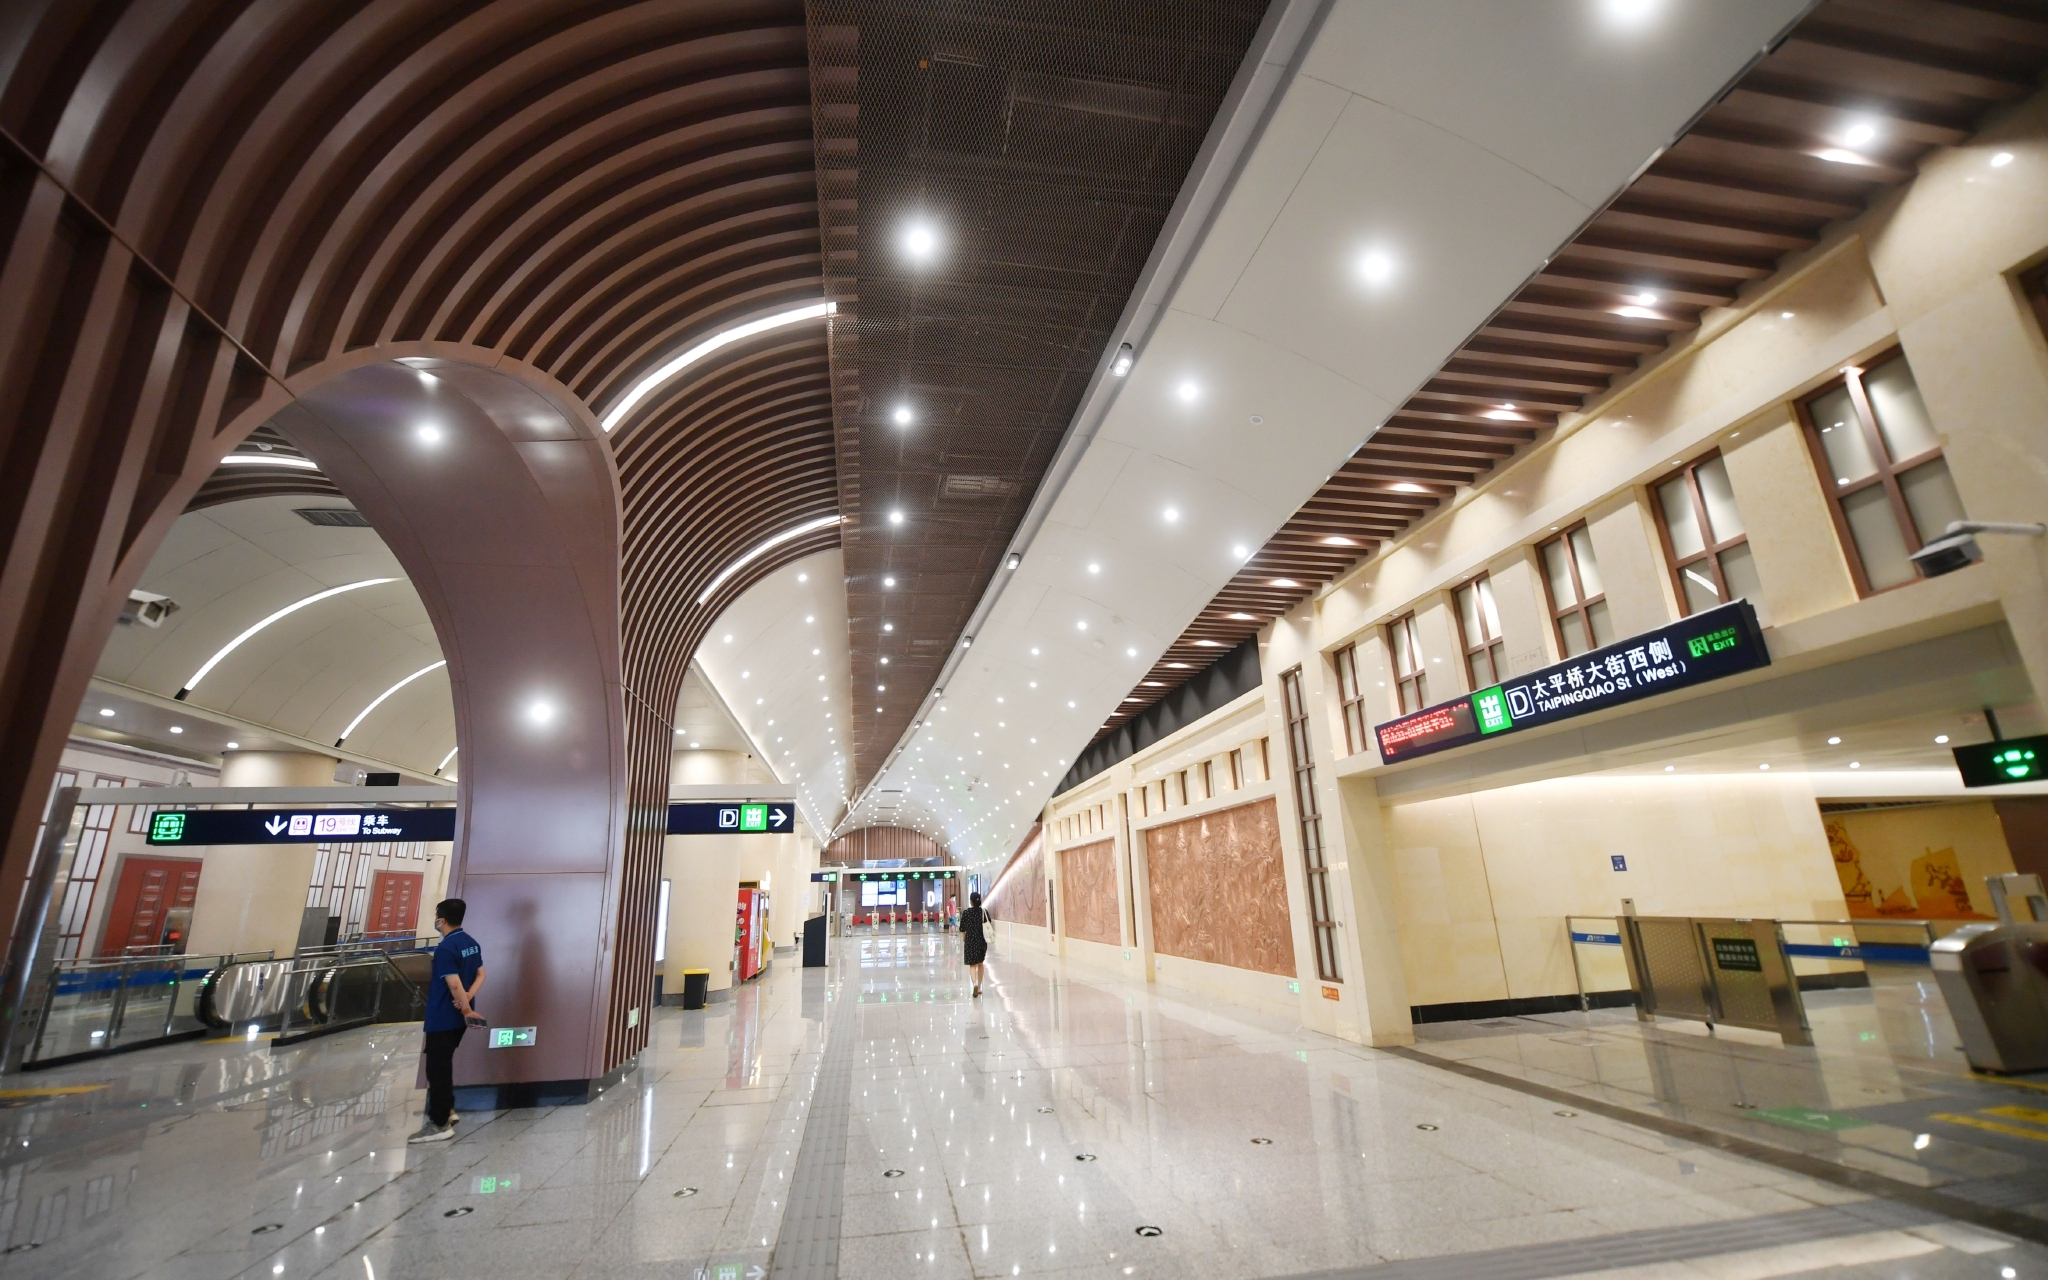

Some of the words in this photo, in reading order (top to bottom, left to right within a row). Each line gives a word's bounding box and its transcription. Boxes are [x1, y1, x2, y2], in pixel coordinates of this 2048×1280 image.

[1713, 637, 1735, 651] EXIT
[1532, 637, 1674, 700] 太平桥大街西侧
[1536, 681, 1615, 712] TAIPINGQIAO
[1617, 676, 1633, 691] St
[1479, 693, 1503, 719] 出
[1508, 690, 1529, 716] D
[1485, 715, 1503, 728] EXIT
[363, 815, 389, 826] 乘车
[722, 811, 736, 825] D
[745, 808, 762, 822] 出
[319, 817, 337, 832] 19
[362, 827, 371, 835] To
[372, 827, 402, 836] Subway
[927, 890, 935, 907] D
